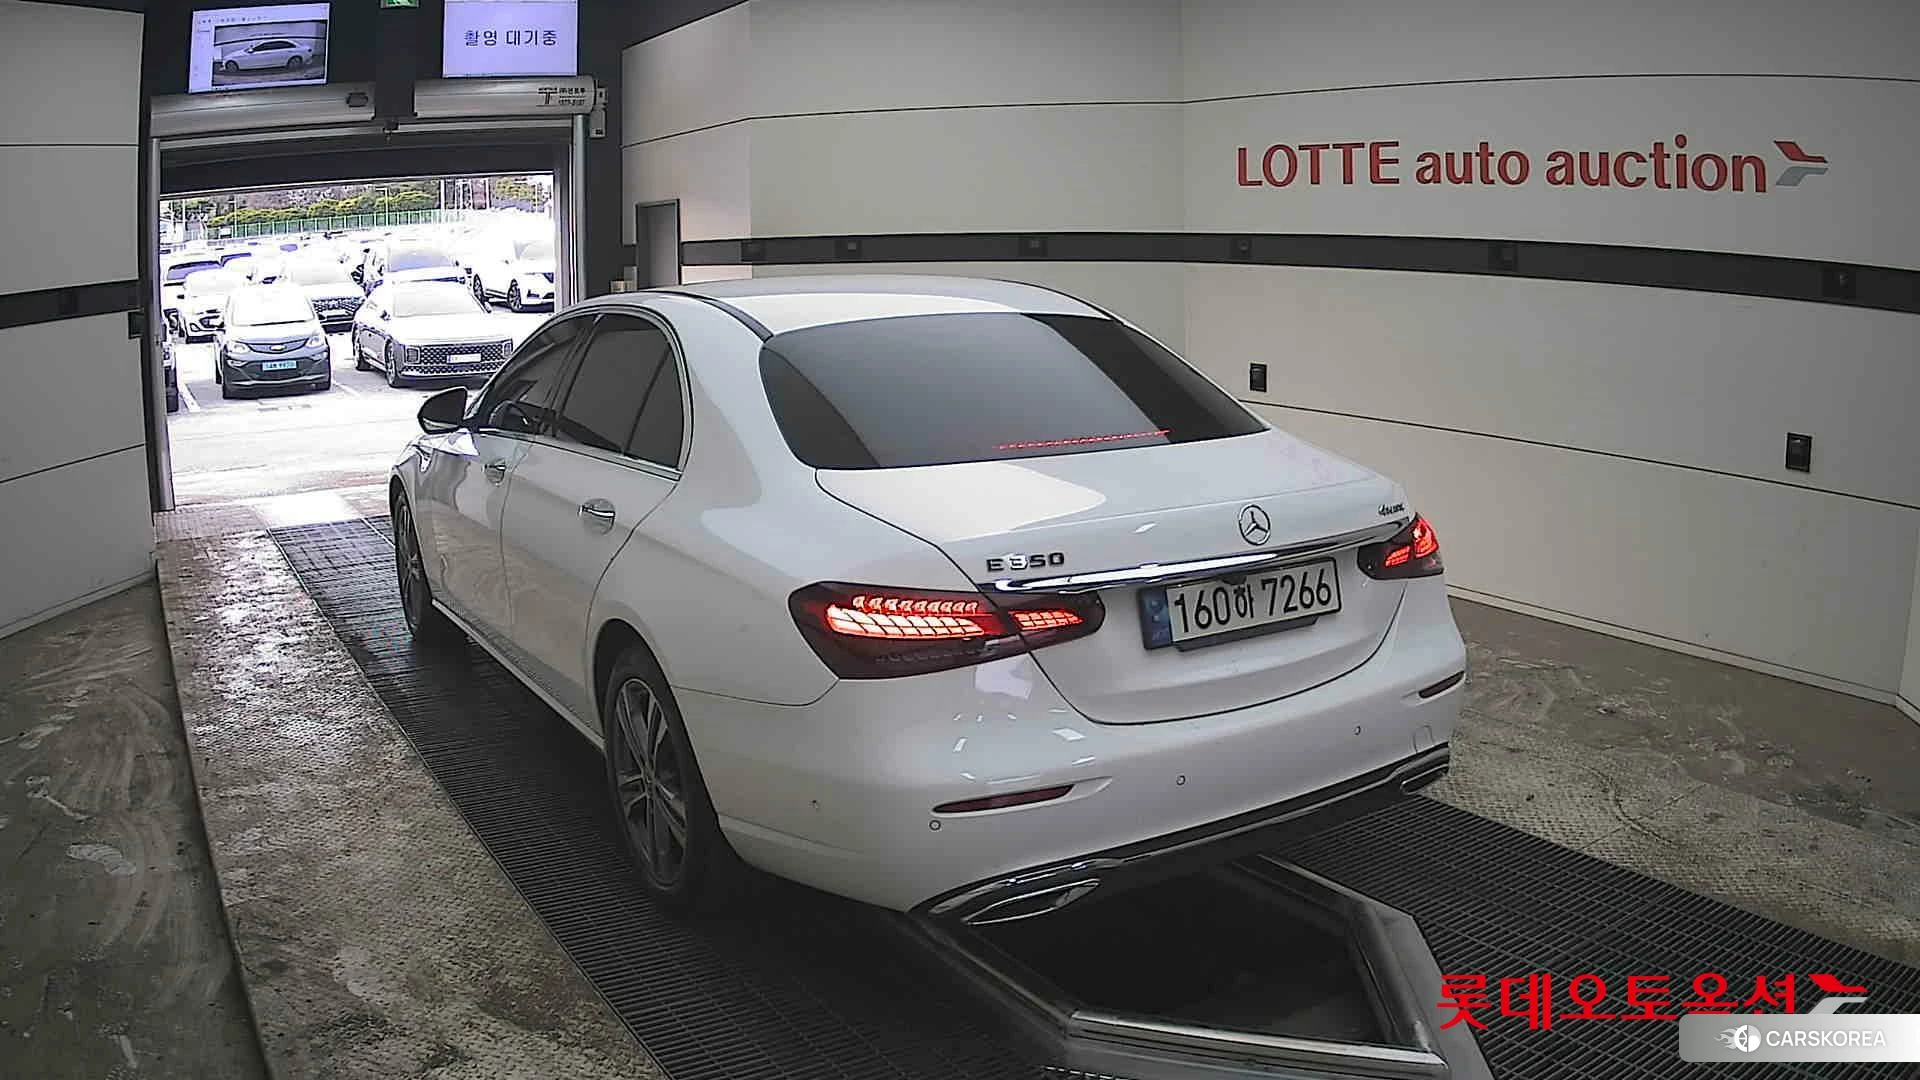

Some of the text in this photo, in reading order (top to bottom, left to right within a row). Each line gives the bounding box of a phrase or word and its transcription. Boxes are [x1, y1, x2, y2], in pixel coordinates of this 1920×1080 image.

[465, 29, 557, 47] 촬영 대기중
[1236, 133, 1767, 193] LOTTE auto auction
[986, 552, 1065, 572] E 350
[1174, 568, 1332, 633] 160하 7266
